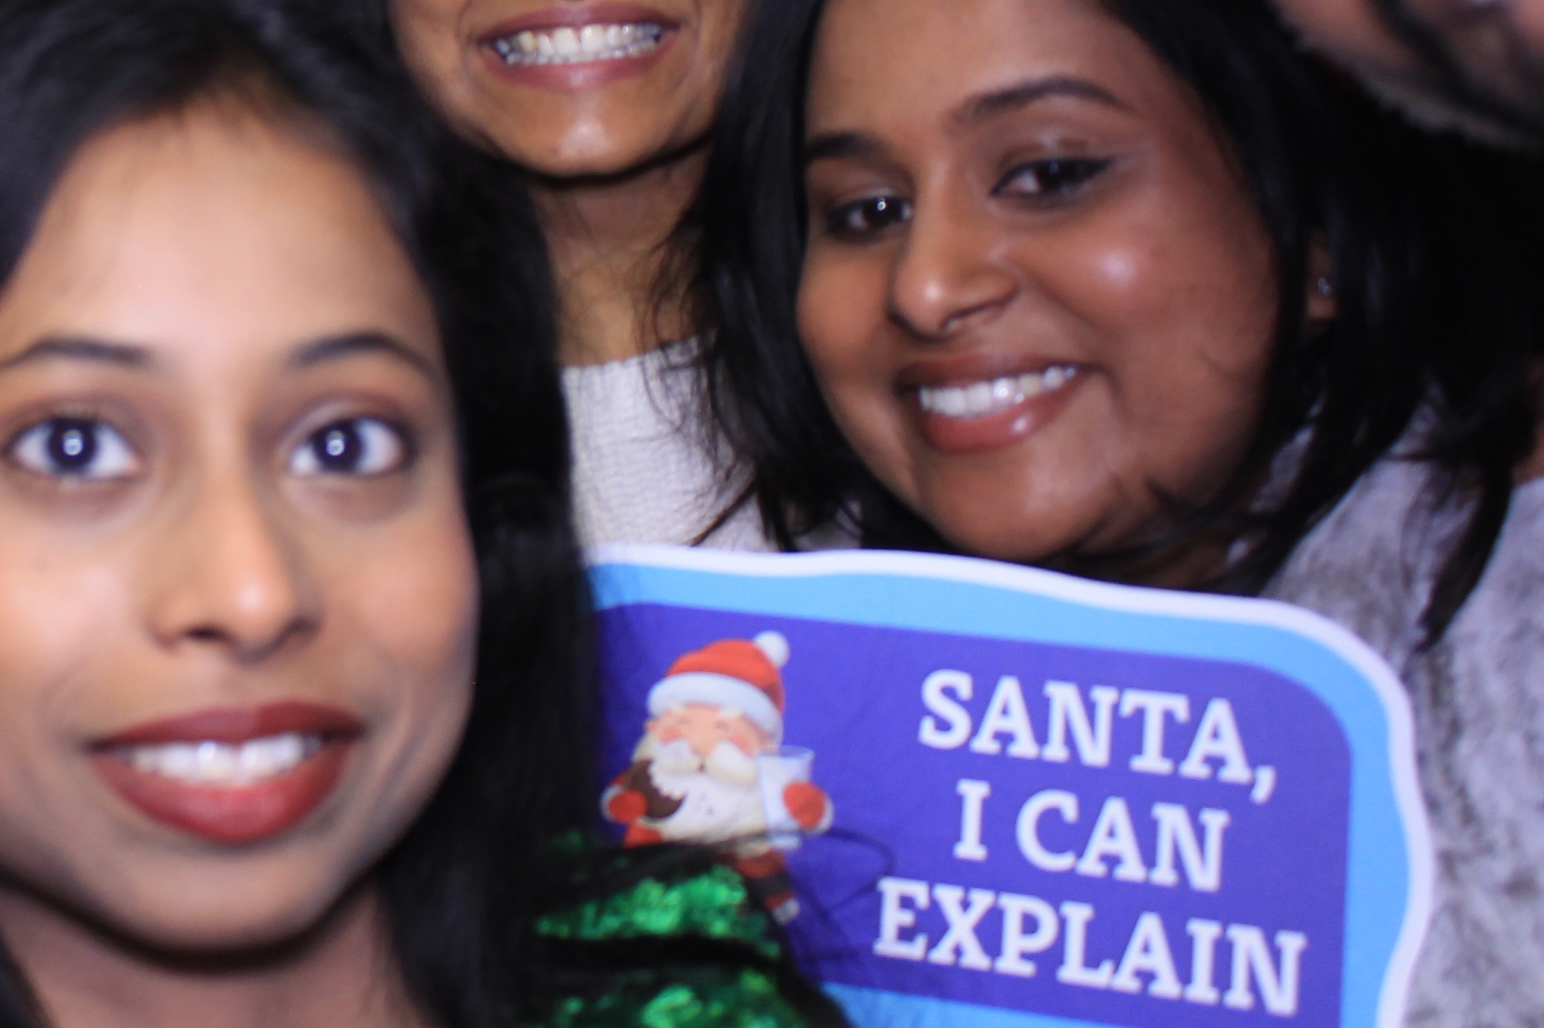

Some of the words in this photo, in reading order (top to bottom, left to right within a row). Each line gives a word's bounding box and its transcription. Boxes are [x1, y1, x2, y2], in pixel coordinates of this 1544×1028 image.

[917, 668, 1277, 803] SANTA,
[953, 778, 991, 861] I
[1015, 789, 1230, 892] CAN
[873, 877, 1307, 1016] EXPLAIN
